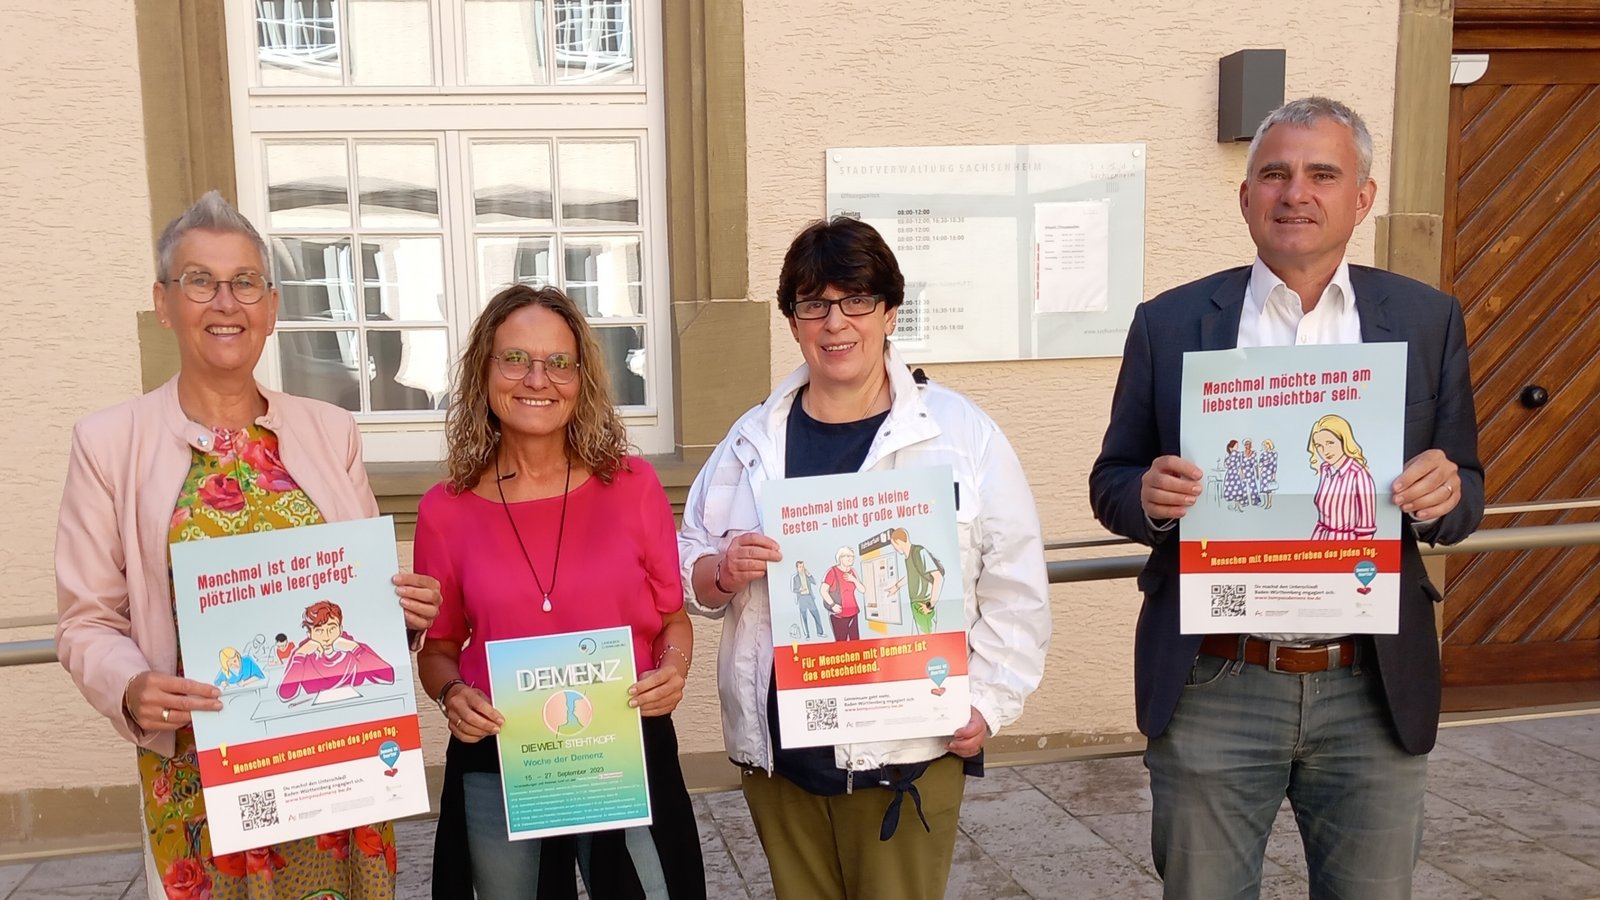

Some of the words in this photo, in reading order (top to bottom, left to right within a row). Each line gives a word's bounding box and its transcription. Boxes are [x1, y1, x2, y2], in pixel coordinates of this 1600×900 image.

[839, 163, 954, 176] STADTVERWALTUNG
[959, 162, 1042, 174] SACHSENHEIM
[1203, 376, 1264, 396] Manchmal
[1269, 373, 1316, 389] möchte
[1321, 370, 1347, 385] man
[1352, 369, 1371, 382] am
[1202, 396, 1253, 413] liebsten
[1258, 390, 1327, 408] unsichtbar
[1331, 387, 1361, 401] sein.
[781, 500, 833, 520] Manchmal
[837, 496, 858, 511] sind
[862, 494, 874, 507] es
[878, 490, 909, 505] kleine
[782, 519, 819, 535] Gesten
[832, 512, 859, 528] nicht
[863, 508, 893, 528] große
[197, 563, 262, 590] Manchmal
[267, 559, 285, 577] ist
[290, 555, 312, 571] der
[316, 547, 345, 566] Kopf
[1210, 555, 1247, 567] Menschen
[1249, 554, 1262, 564] mit
[1263, 552, 1292, 563] Demenz
[1293, 550, 1323, 561] erleben
[1324, 549, 1338, 559] das
[1339, 548, 1361, 560] jeden
[1362, 547, 1378, 558] Tag.
[199, 584, 256, 613] plötzlich
[260, 579, 283, 596] wie
[287, 564, 357, 591] leergefegt.
[801, 657, 816, 670] Für
[819, 652, 860, 668] Menschen
[863, 648, 878, 660] mit
[880, 643, 912, 658] Demenz
[914, 640, 927, 652] ist
[516, 658, 623, 692] DEMENZ
[803, 670, 818, 682] das
[820, 661, 880, 679] entscheidend.
[233, 755, 271, 775] Menschen
[272, 752, 286, 765] mit
[287, 746, 316, 761] Demenz
[318, 739, 346, 753] erleben
[347, 735, 360, 746] das
[361, 729, 381, 745] jeden
[383, 726, 398, 738] Tag.
[523, 758, 551, 767] Woche
[554, 755, 568, 764] der
[571, 752, 603, 762] Demenz
[557, 769, 587, 778] September
